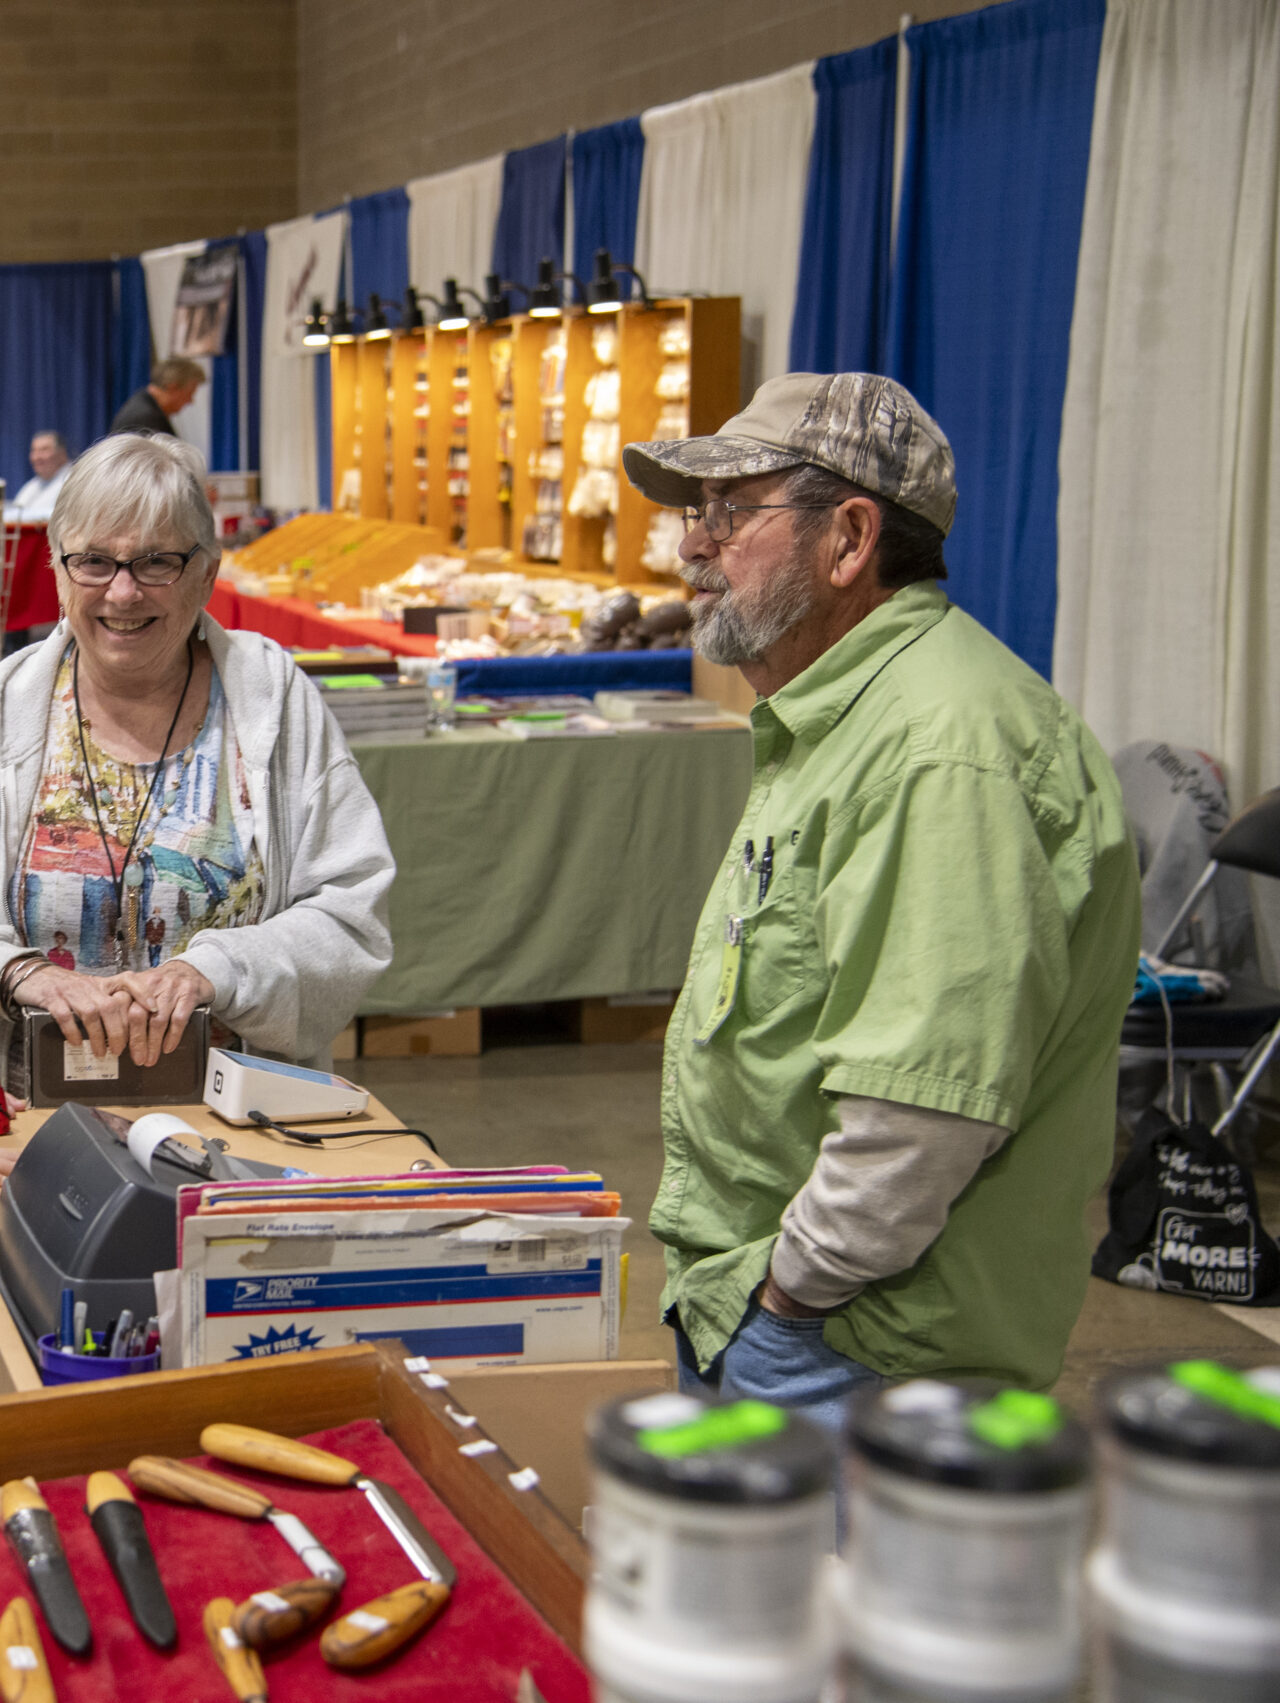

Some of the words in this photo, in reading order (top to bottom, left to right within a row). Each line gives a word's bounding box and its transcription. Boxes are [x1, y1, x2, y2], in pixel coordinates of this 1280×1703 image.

[246, 1223, 264, 1232] Flat
[267, 1223, 289, 1231] Rate
[292, 1222, 335, 1231] Envelope
[1161, 1241, 1248, 1268] MORE
[267, 1276, 319, 1290] PRIORITY
[1190, 1268, 1248, 1293] YARN!
[265, 1287, 295, 1300] MAIL
[250, 1343, 272, 1358] TRY
[273, 1336, 302, 1353] FREE
